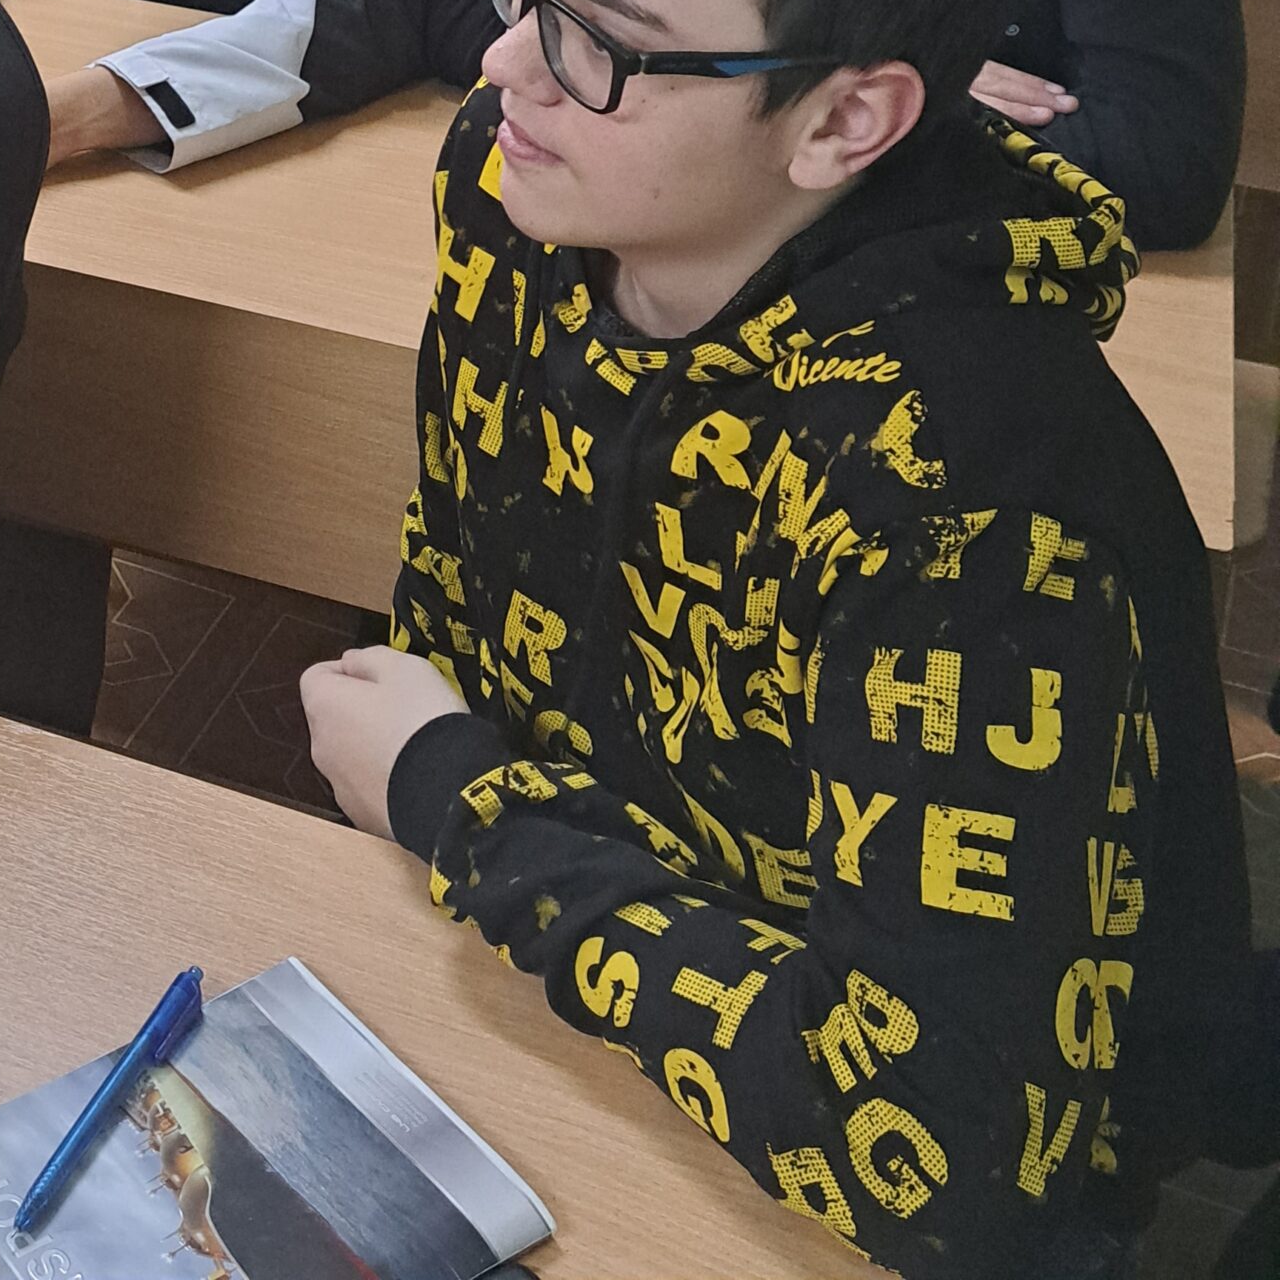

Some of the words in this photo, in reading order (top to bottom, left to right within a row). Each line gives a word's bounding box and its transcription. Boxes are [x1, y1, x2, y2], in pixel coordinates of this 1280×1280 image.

[768, 350, 903, 392] Vicente
[671, 410, 756, 489] R
[504, 591, 568, 686] R
[865, 648, 962, 754] H
[986, 668, 1063, 771] J
[829, 780, 897, 886] Y
[921, 804, 1015, 921] E
[575, 936, 640, 1028] S
[845, 1098, 948, 1220] G
